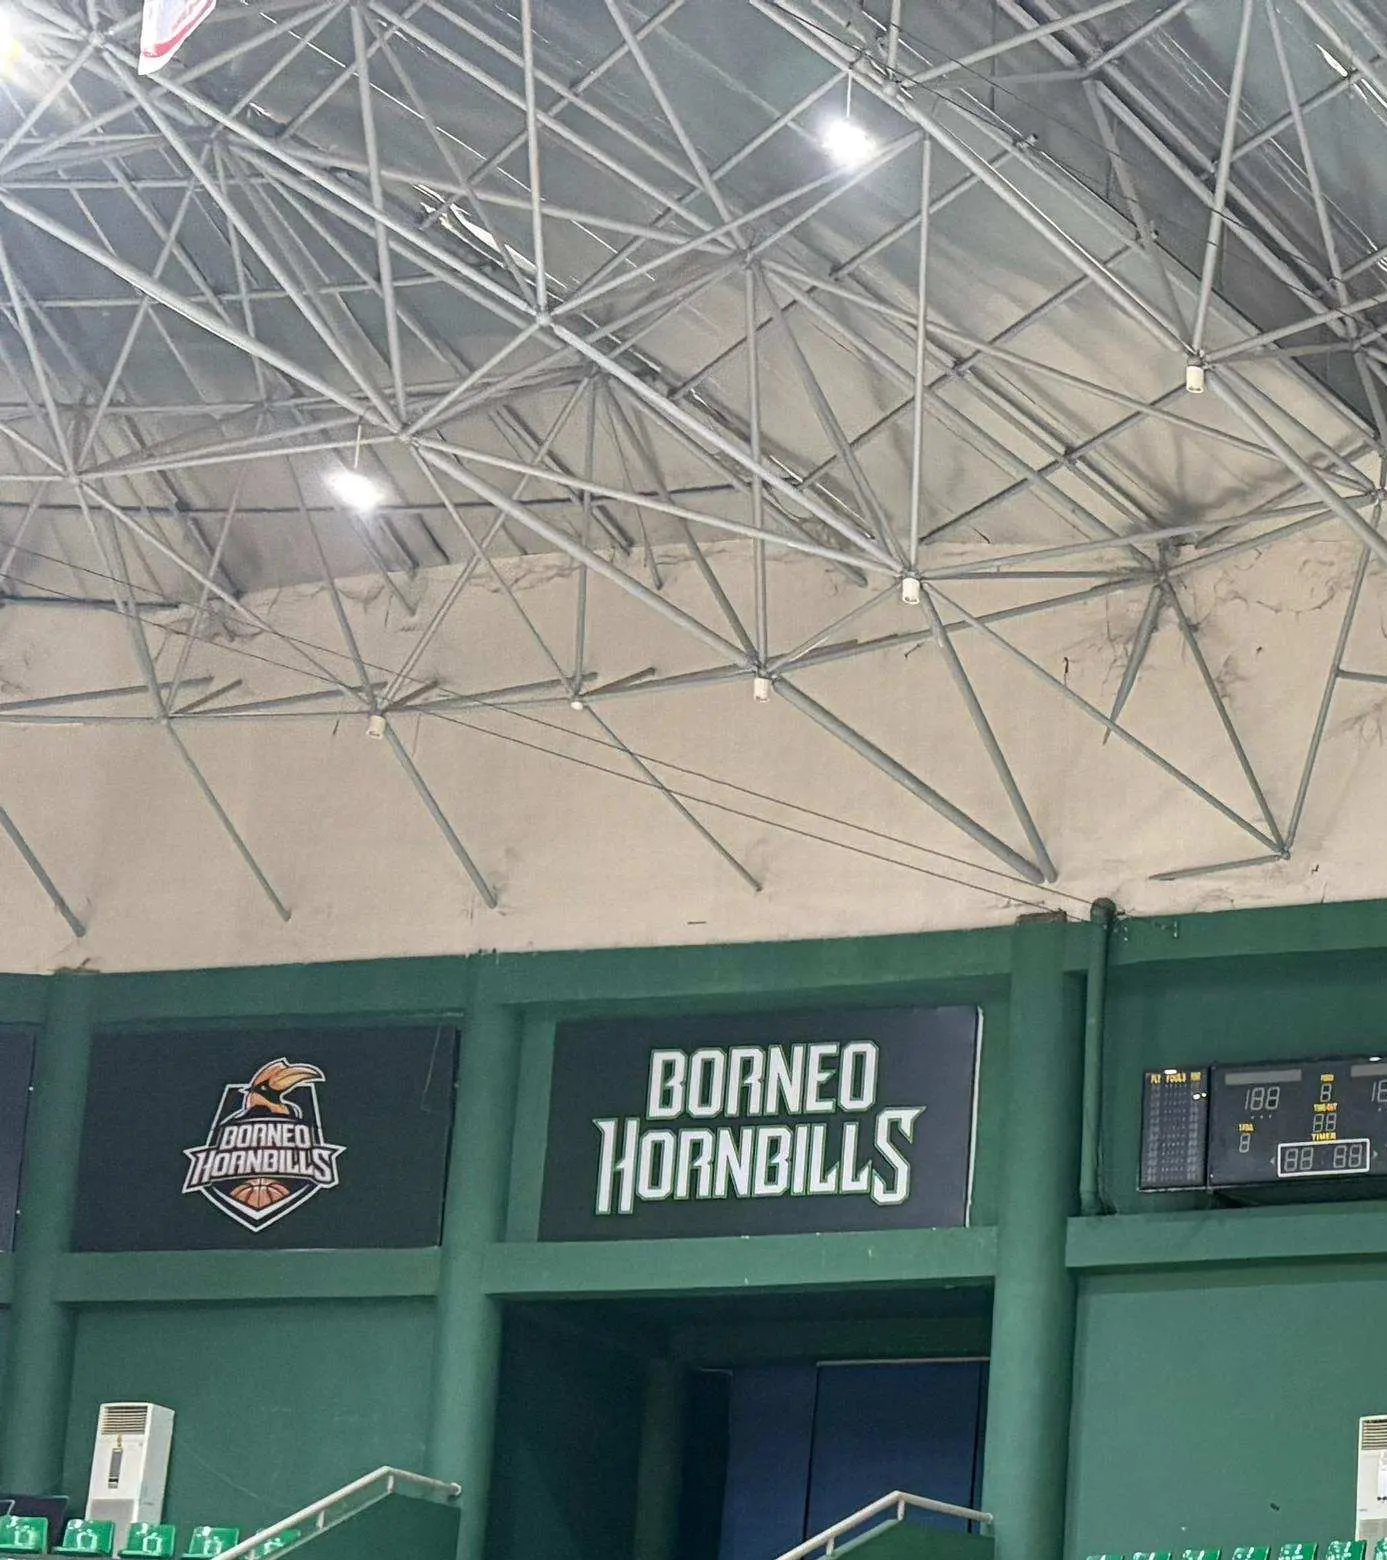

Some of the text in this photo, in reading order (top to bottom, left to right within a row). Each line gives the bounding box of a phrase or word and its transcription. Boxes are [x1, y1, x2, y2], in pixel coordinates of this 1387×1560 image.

[647, 1038, 880, 1120] BORNEO
[219, 1124, 311, 1150] BORNEO
[592, 1105, 926, 1216] HORNBILLS
[191, 1149, 333, 1184] HORNBILLS
